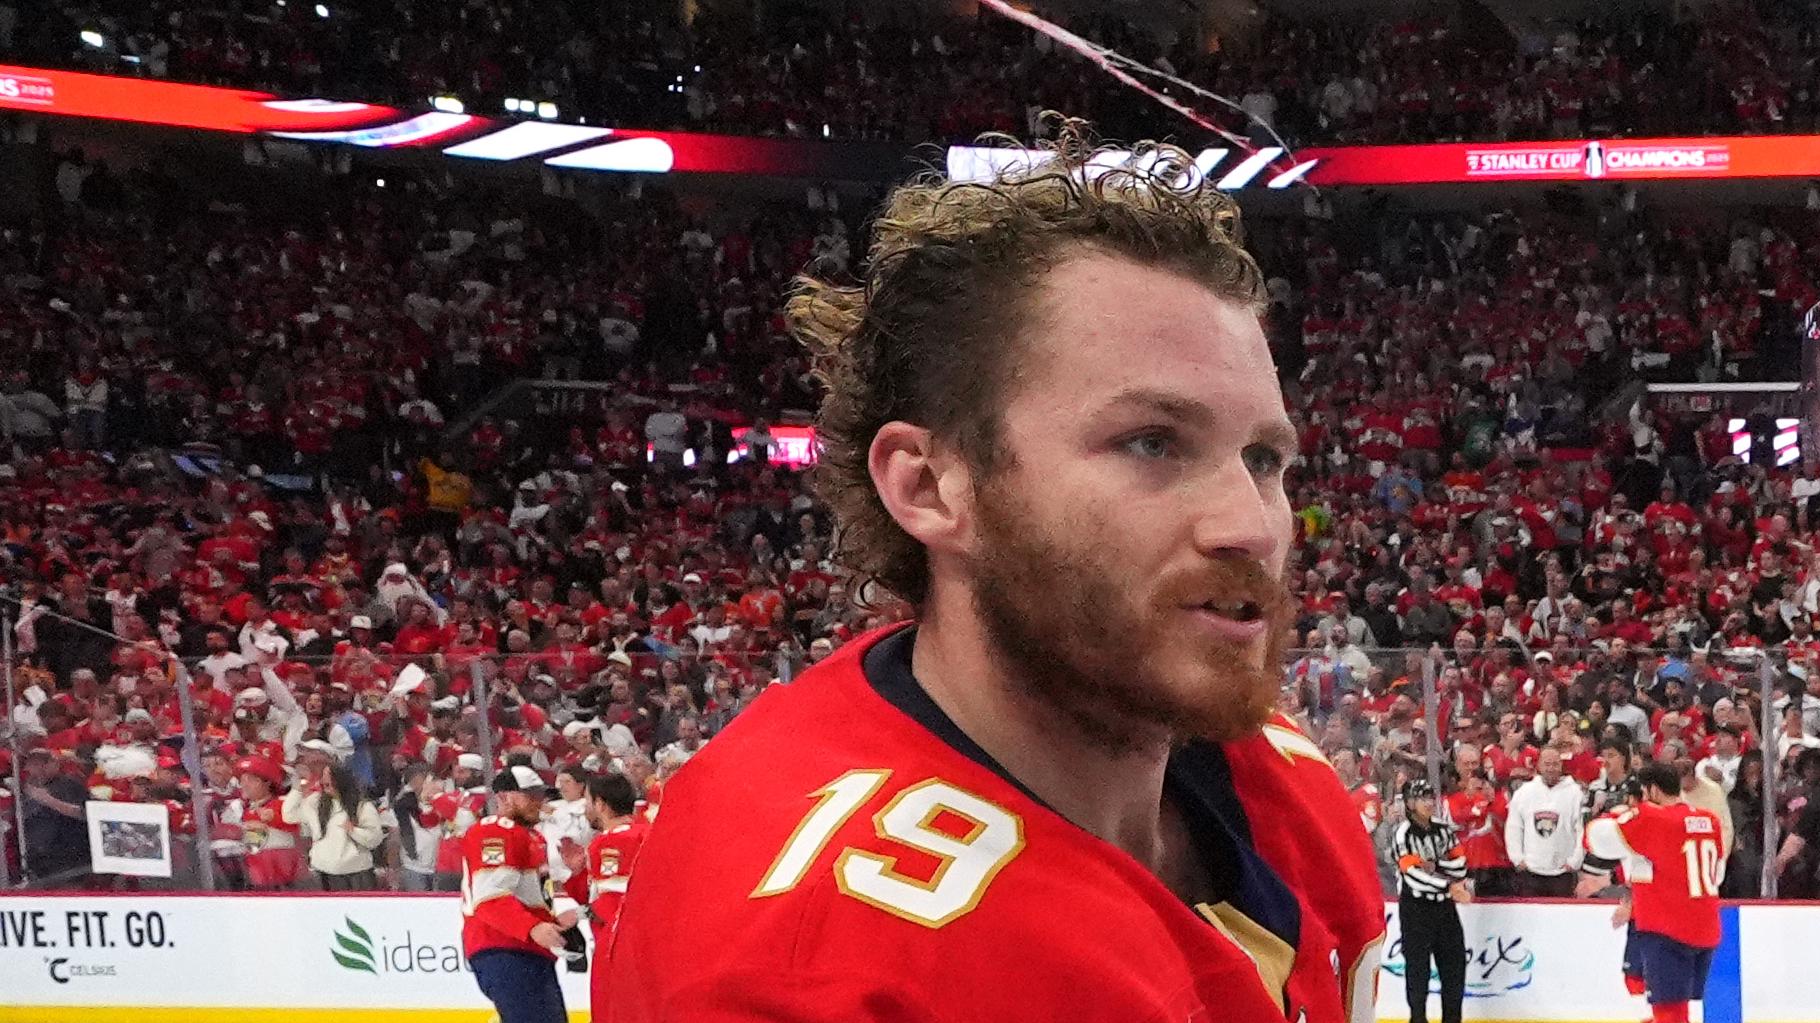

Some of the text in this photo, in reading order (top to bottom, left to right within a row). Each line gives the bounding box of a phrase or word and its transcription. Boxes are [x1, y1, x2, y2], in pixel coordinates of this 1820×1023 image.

[1481, 153, 1547, 171] STANLEY
[1550, 151, 1582, 169] CUP
[1606, 150, 1705, 168] CHAMPIONS
[749, 768, 1027, 929] 19
[1681, 839, 1721, 898] 10
[0, 911, 174, 947] IVE. FIT. GO.
